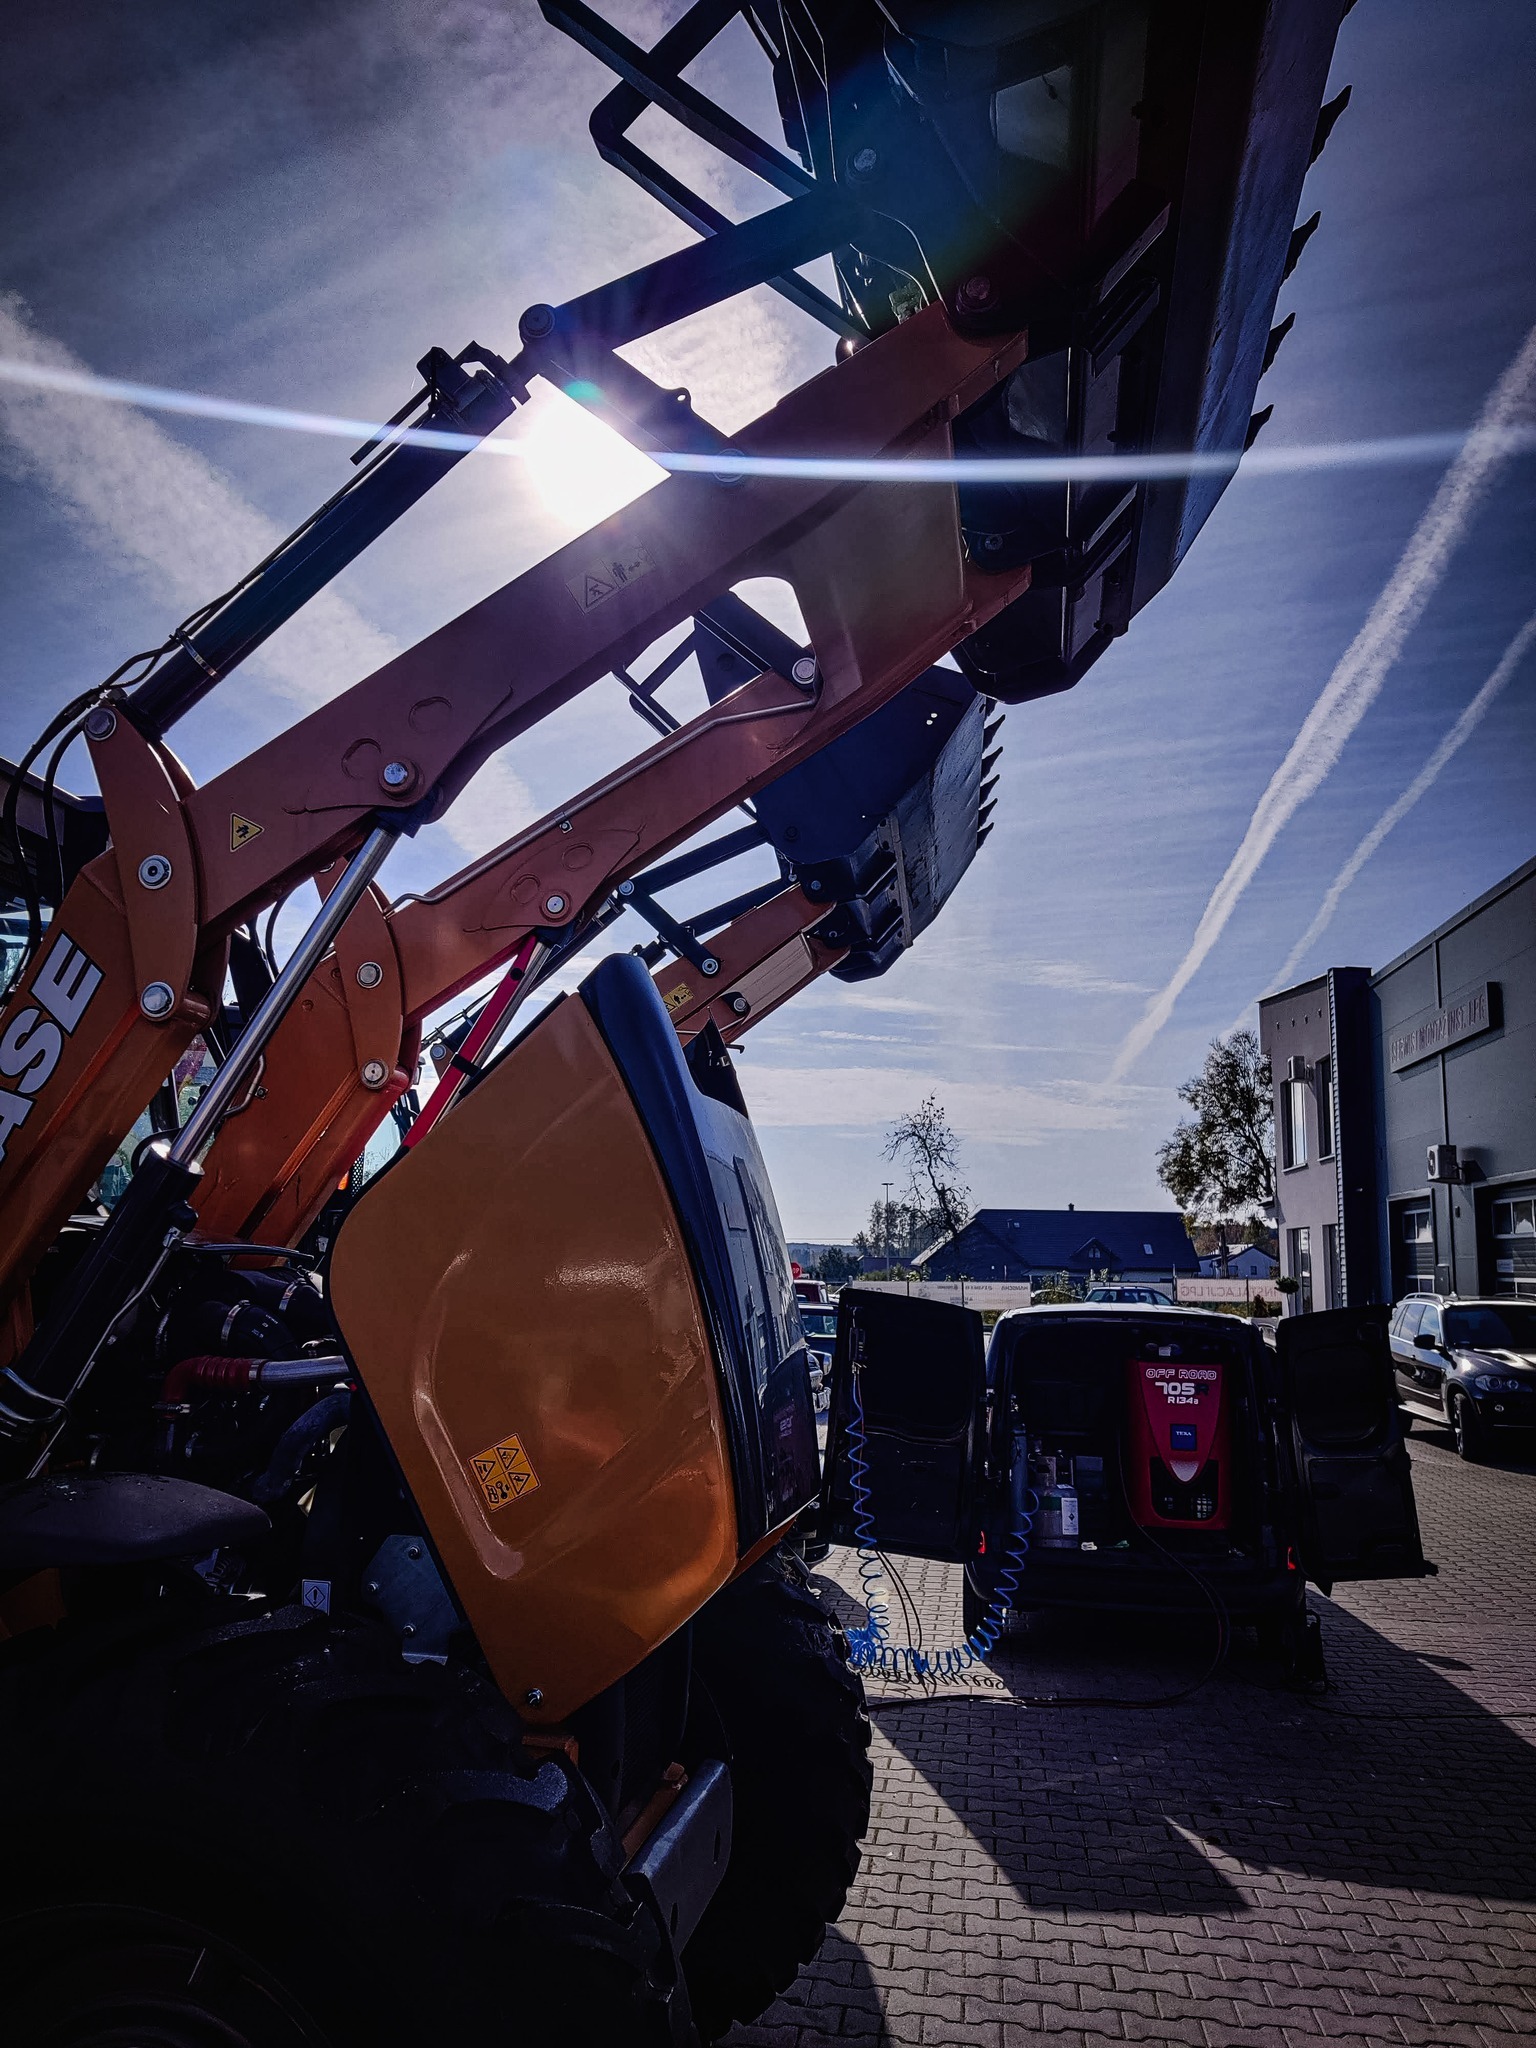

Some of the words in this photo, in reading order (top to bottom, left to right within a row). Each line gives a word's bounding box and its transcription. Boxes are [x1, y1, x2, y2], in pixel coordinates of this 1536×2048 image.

[1468, 994, 1487, 1026] LPG
[0, 929, 105, 1163] ASE
[1146, 1368, 1176, 1379] OFF
[1178, 1369, 1217, 1381] ROAD
